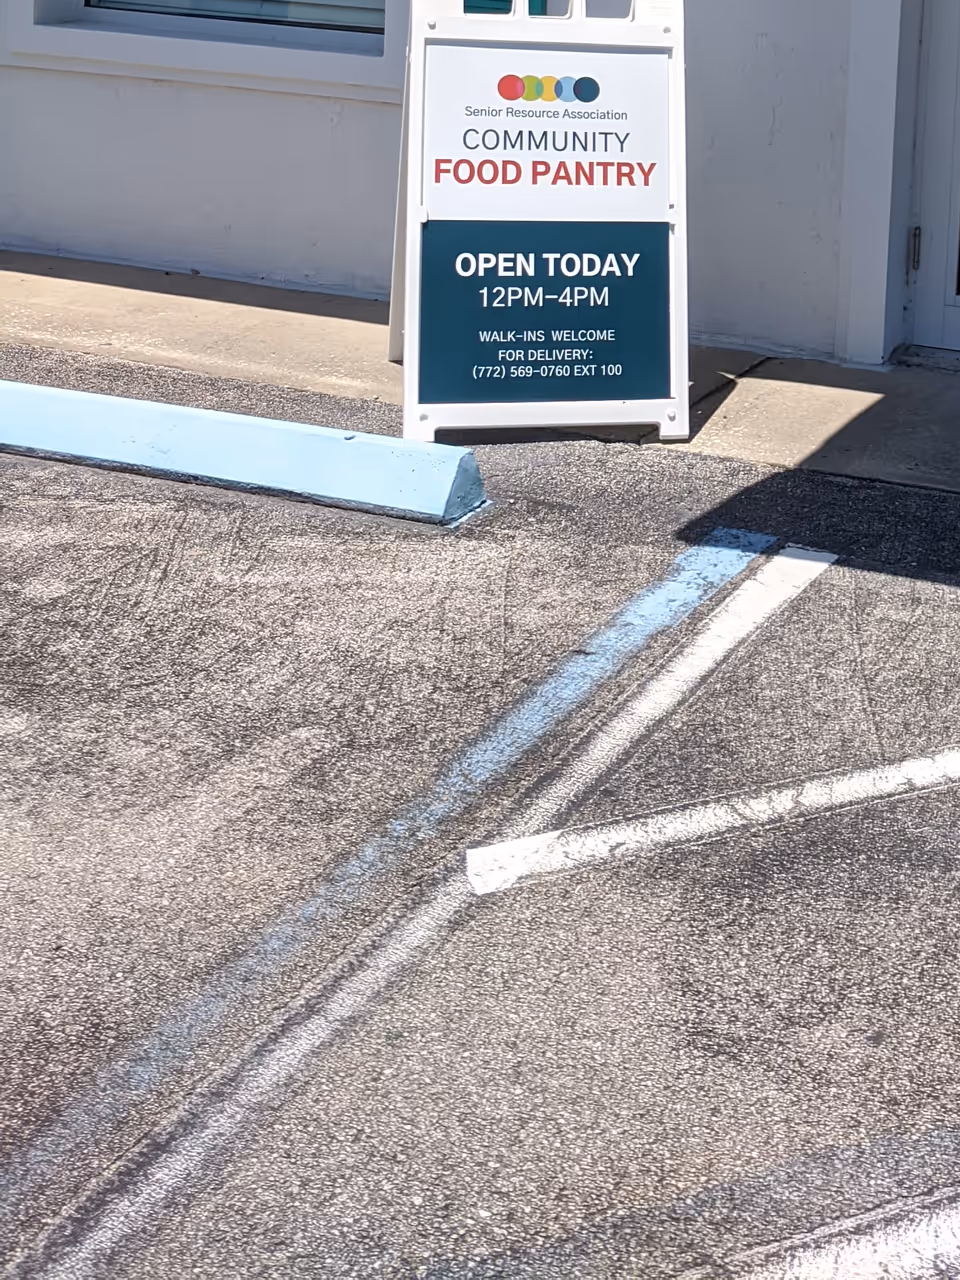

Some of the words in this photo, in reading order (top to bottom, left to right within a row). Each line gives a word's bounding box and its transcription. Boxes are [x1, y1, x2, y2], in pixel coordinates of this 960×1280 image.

[464, 106, 503, 118] Senior
[506, 107, 559, 119] Resource
[562, 108, 628, 120] Association
[462, 128, 630, 153] COMMUNITY
[434, 158, 522, 185] FOOD
[531, 160, 657, 186] PANTRY
[455, 252, 535, 277] OPEN
[542, 253, 640, 277] TODAY
[479, 286, 609, 307] 12PM-4PM
[479, 330, 545, 342] WALK-INS
[551, 329, 616, 341] WELCOME
[498, 349, 525, 361] FOR
[528, 348, 593, 360] DELIVERY:
[472, 365, 506, 380] (772)
[510, 365, 570, 377] 569-0760
[574, 364, 597, 376] EXT
[601, 364, 622, 376] 100
